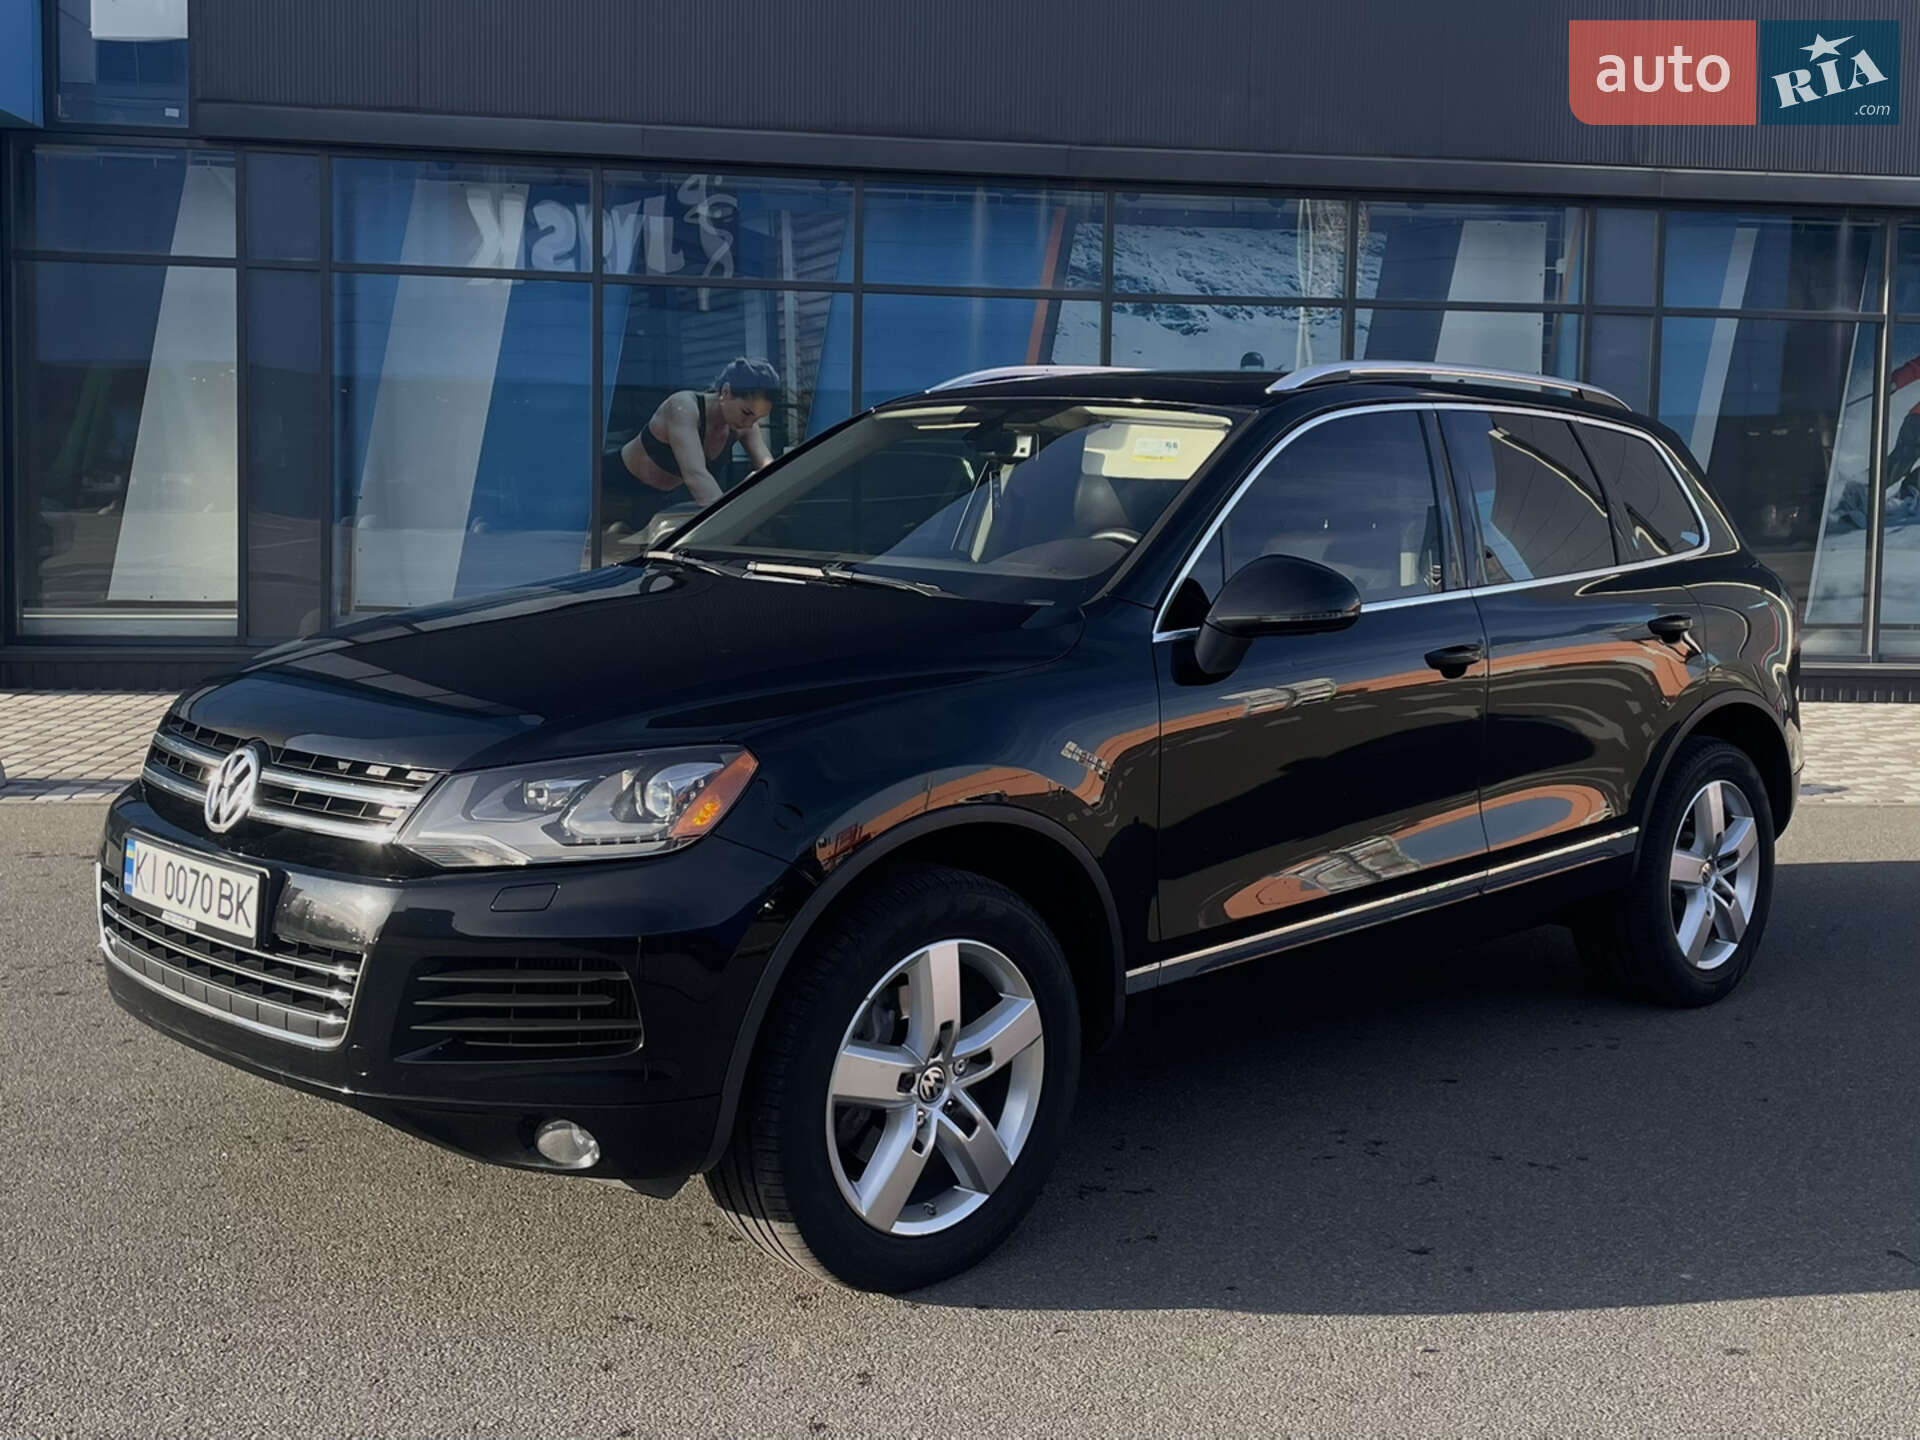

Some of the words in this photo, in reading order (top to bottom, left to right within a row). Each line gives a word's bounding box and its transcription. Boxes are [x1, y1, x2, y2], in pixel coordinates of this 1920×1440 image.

[135, 849, 157, 895] KI
[164, 861, 214, 914] 0070
[217, 877, 255, 929] BK
